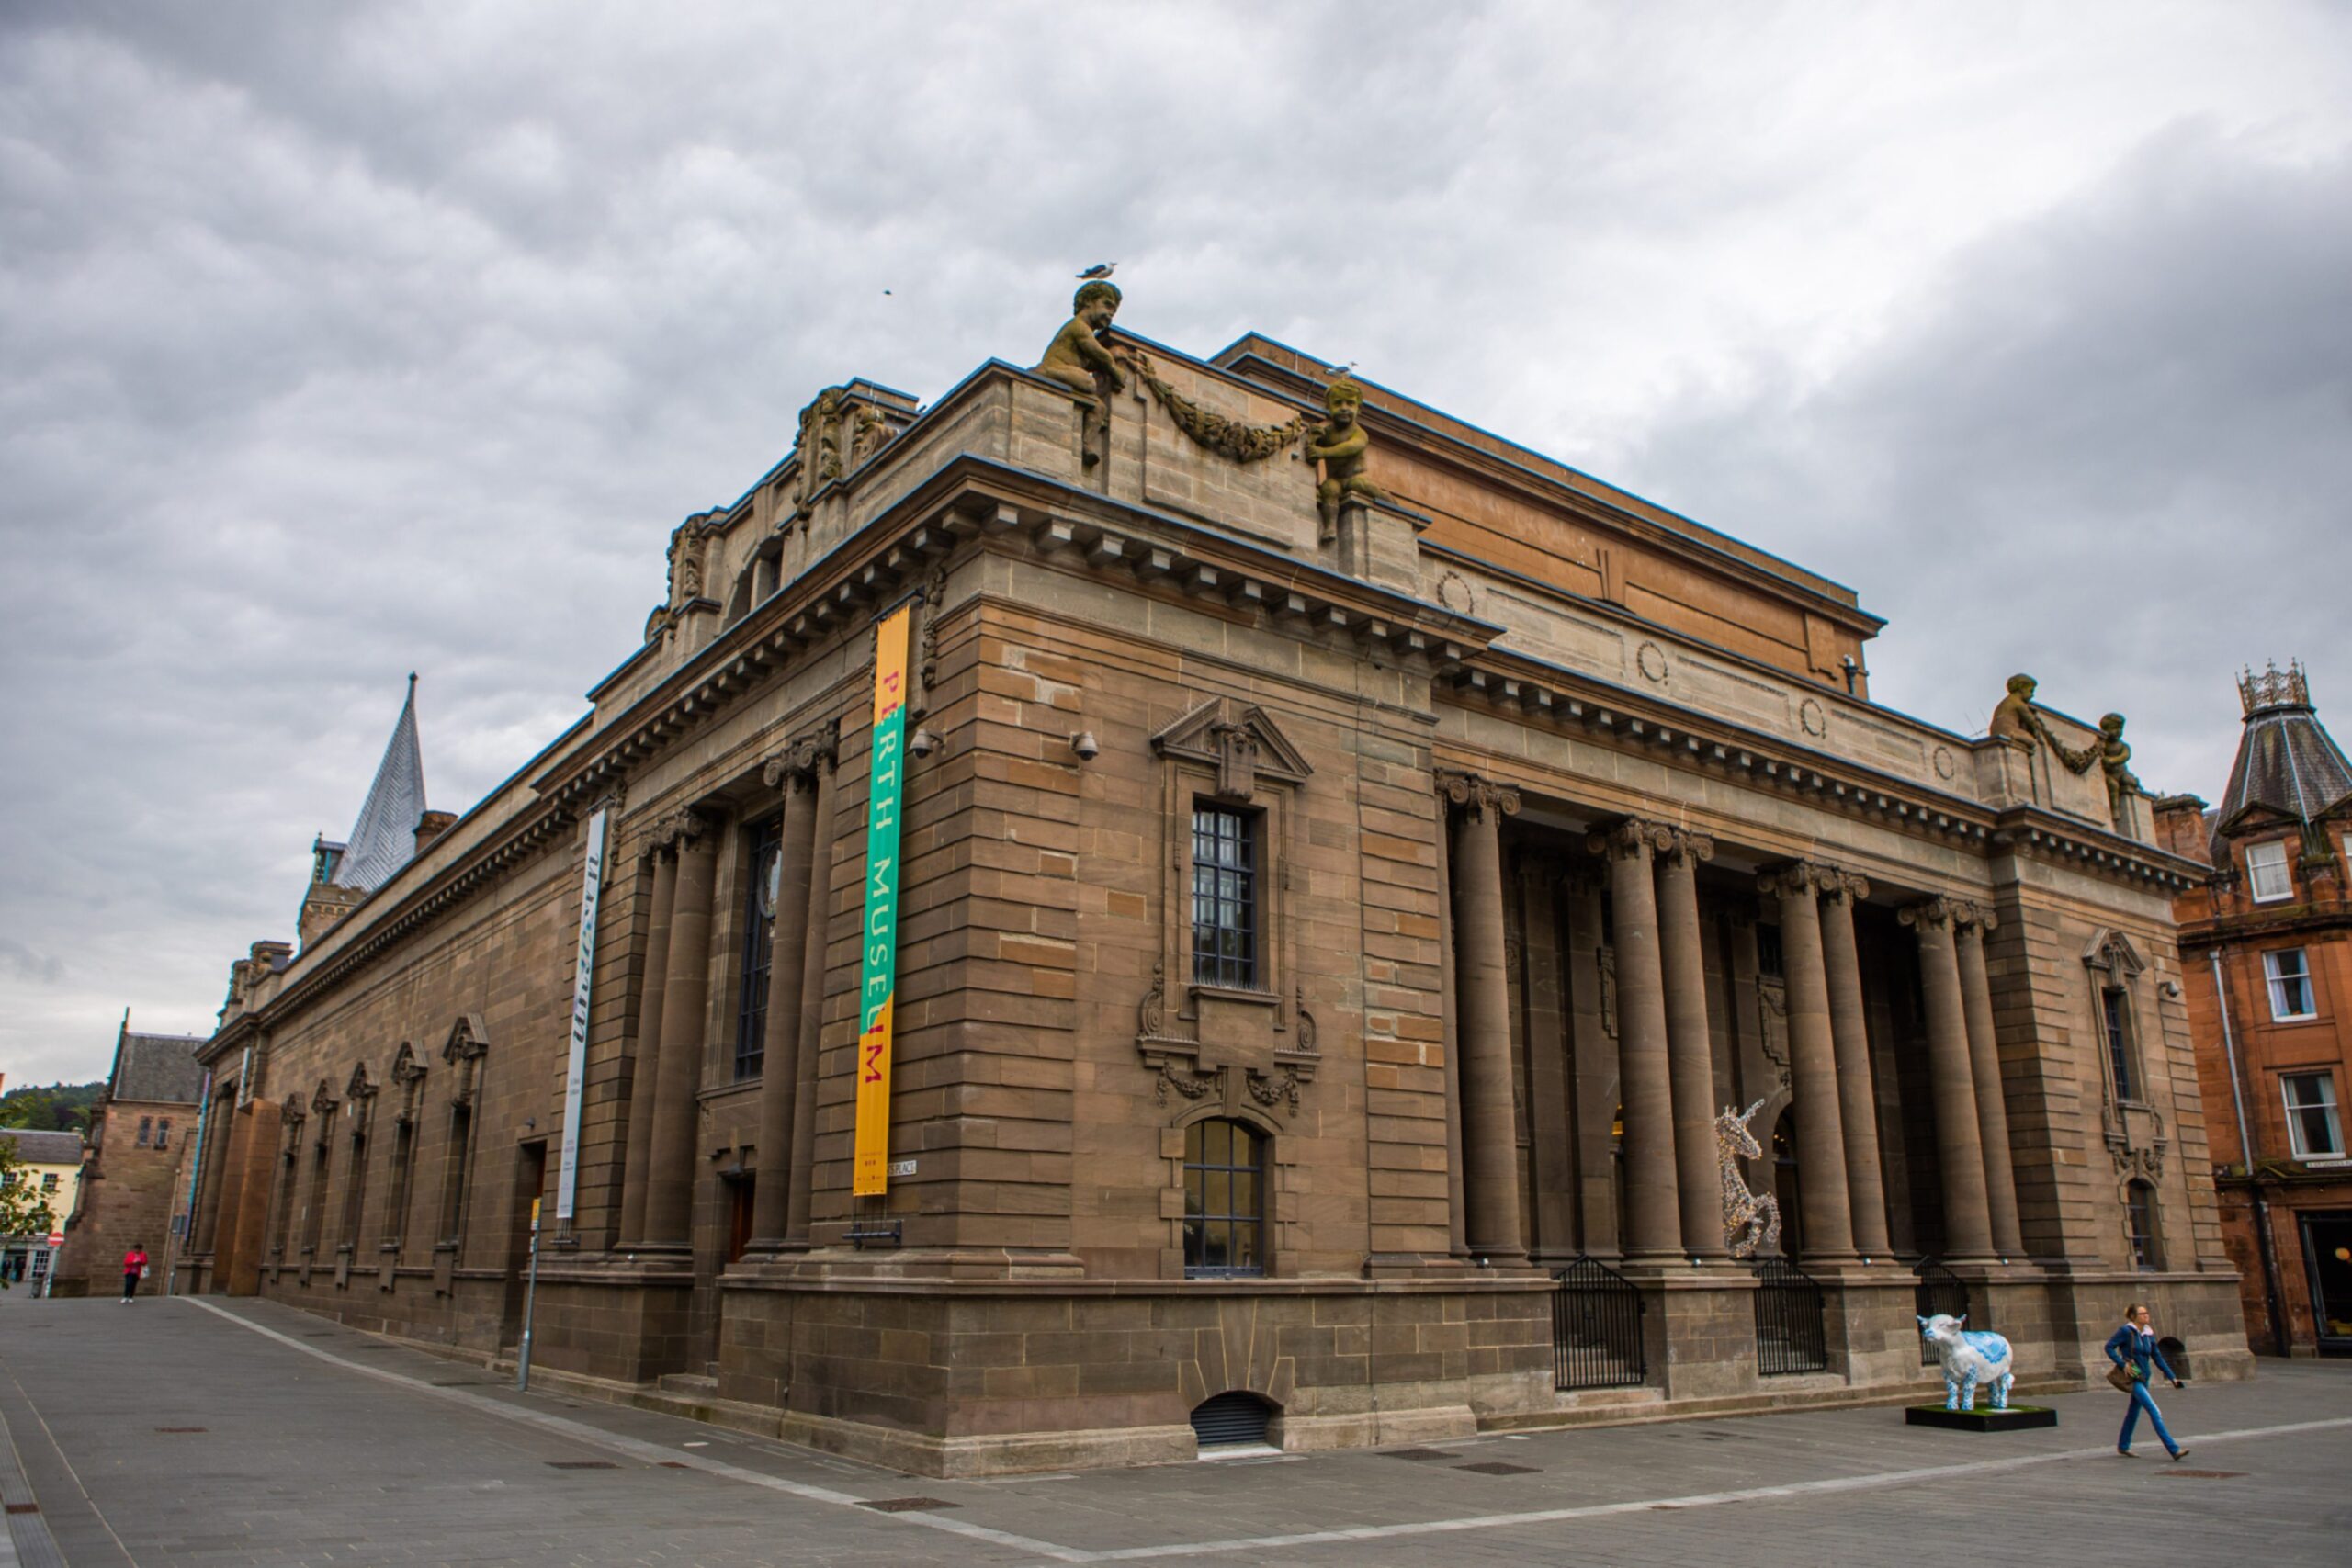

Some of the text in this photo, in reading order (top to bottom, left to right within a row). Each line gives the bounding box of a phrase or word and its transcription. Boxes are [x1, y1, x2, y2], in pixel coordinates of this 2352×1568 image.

[865, 670, 899, 1084] PERTH MUSEUM
[896, 1161, 914, 1174] PLACE
